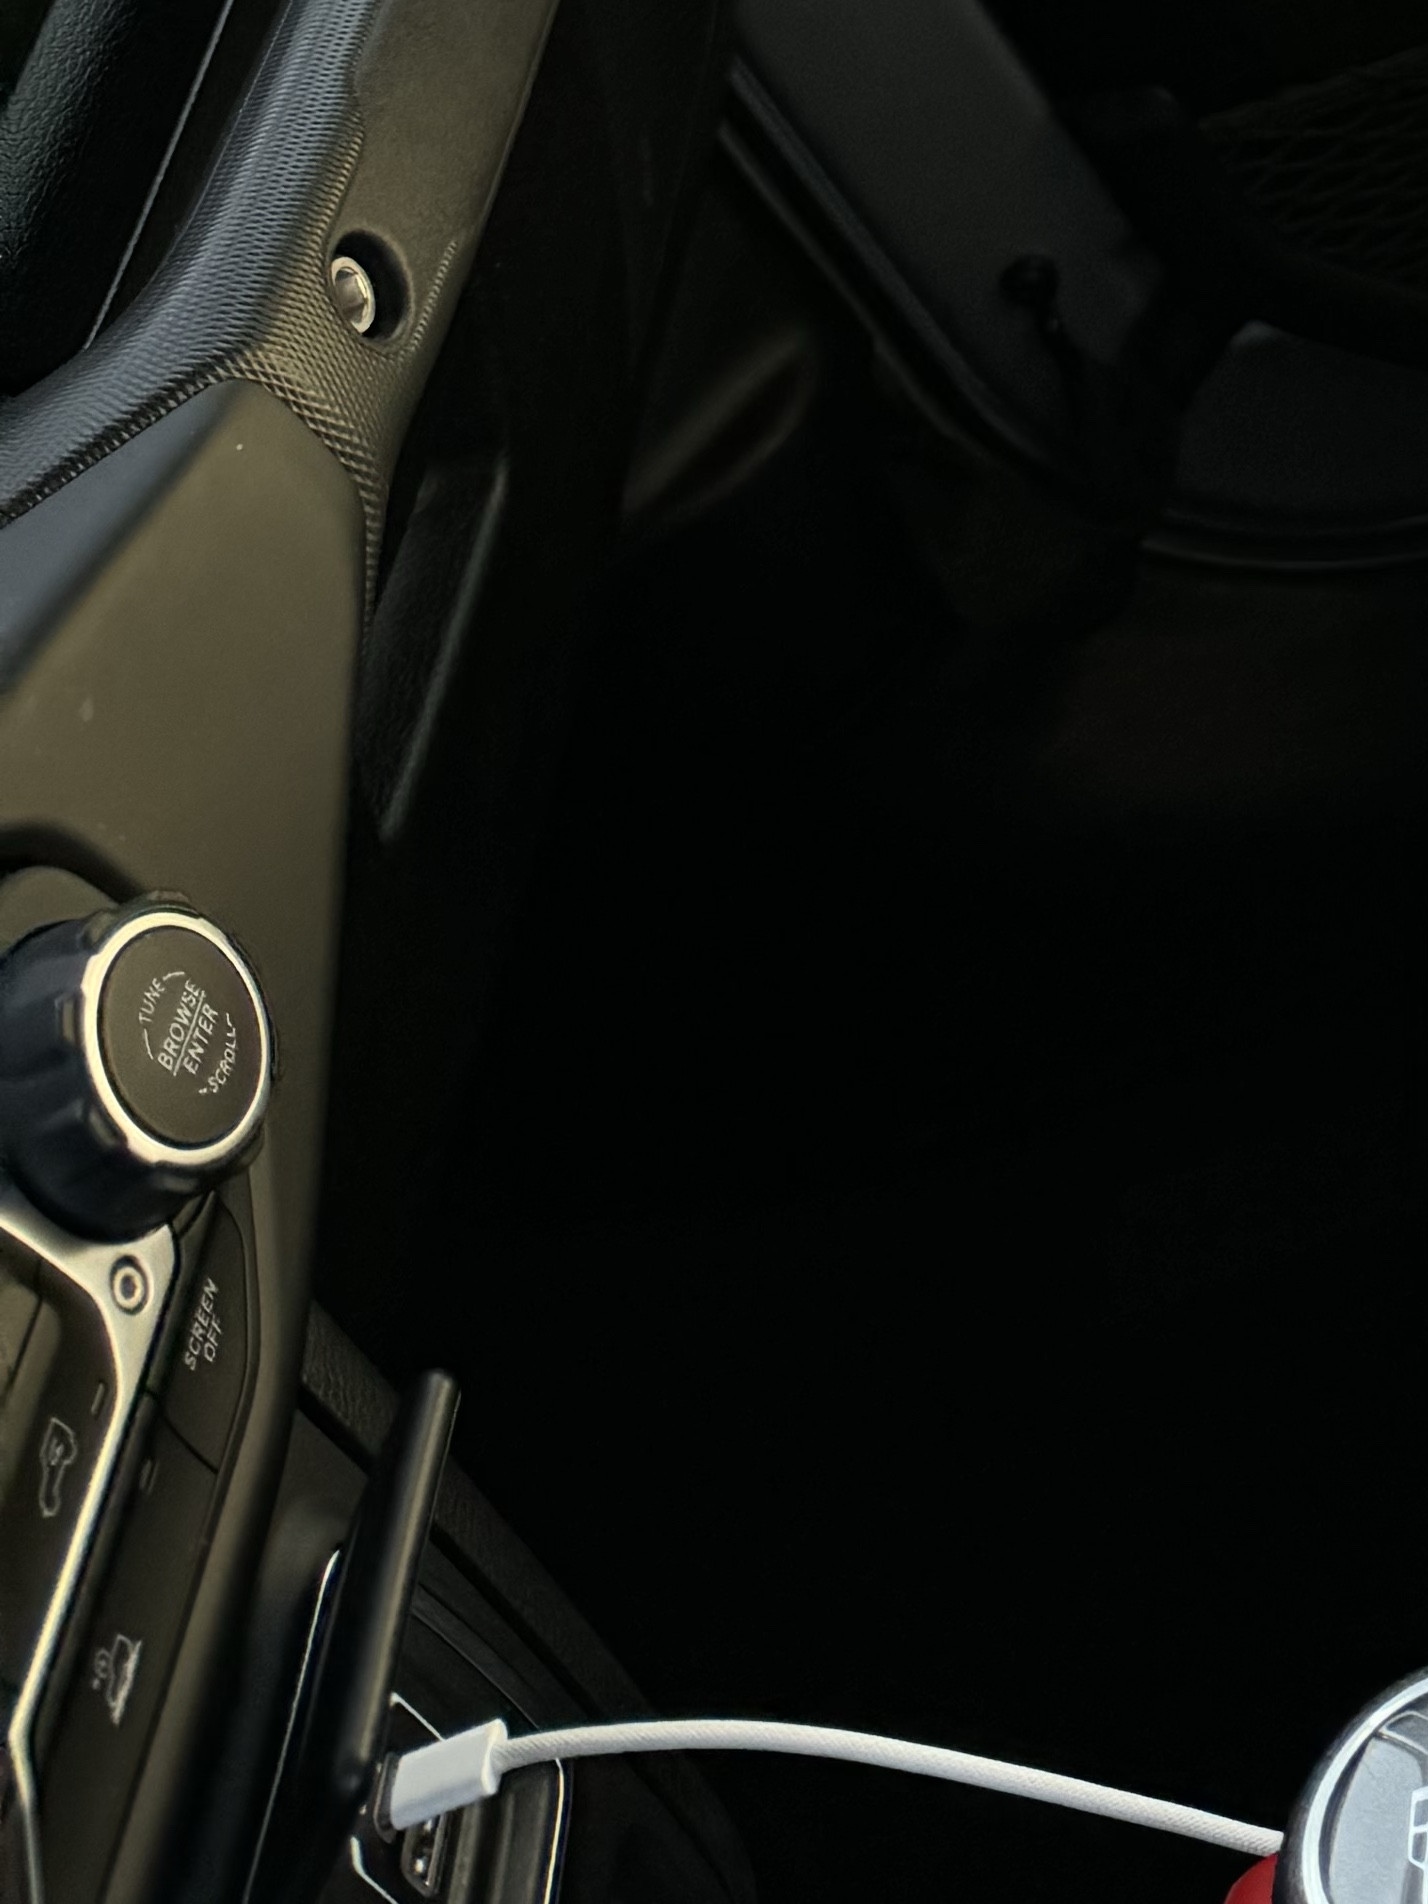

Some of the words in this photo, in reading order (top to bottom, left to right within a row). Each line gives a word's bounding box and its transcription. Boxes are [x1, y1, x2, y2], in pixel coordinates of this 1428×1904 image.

[139, 978, 165, 1023] TUNE
[157, 978, 200, 1071] BROWSE
[183, 1003, 218, 1075] ENTER
[207, 1027, 237, 1093] SCROLL
[184, 1278, 218, 1371] SCREEN
[204, 1312, 222, 1362] OFF
